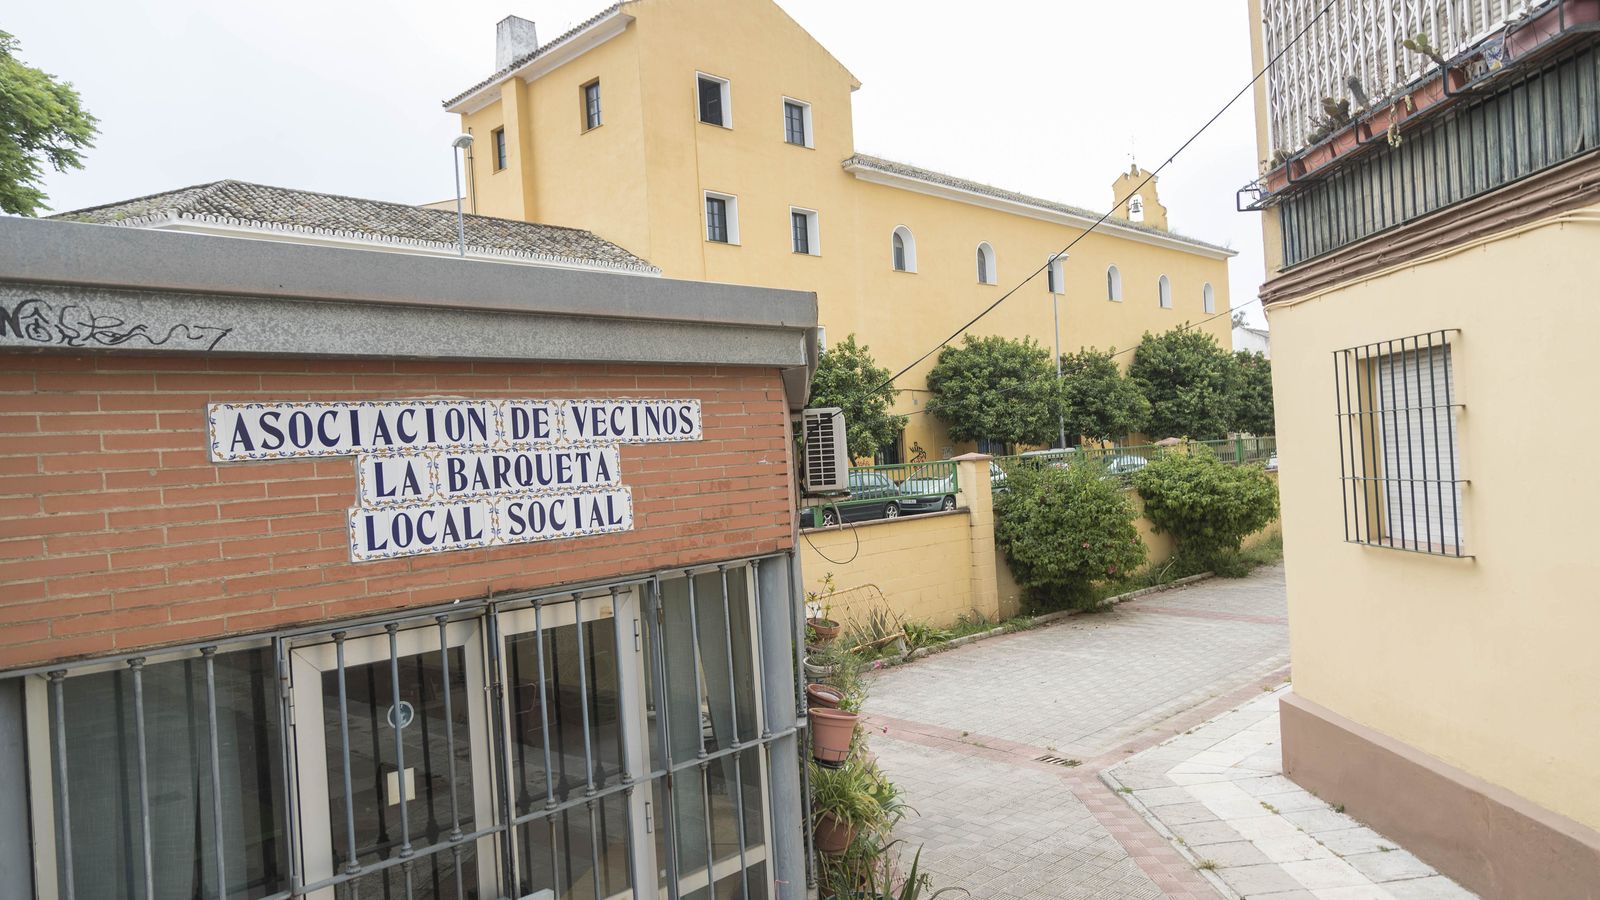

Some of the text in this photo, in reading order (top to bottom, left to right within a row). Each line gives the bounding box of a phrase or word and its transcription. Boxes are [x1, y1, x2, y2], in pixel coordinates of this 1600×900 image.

[230, 405, 694, 451] ASOCIACION DE VECINOS
[374, 452, 611, 498] LA BARQUETA
[366, 493, 623, 551] LOCAL SOCIAL
